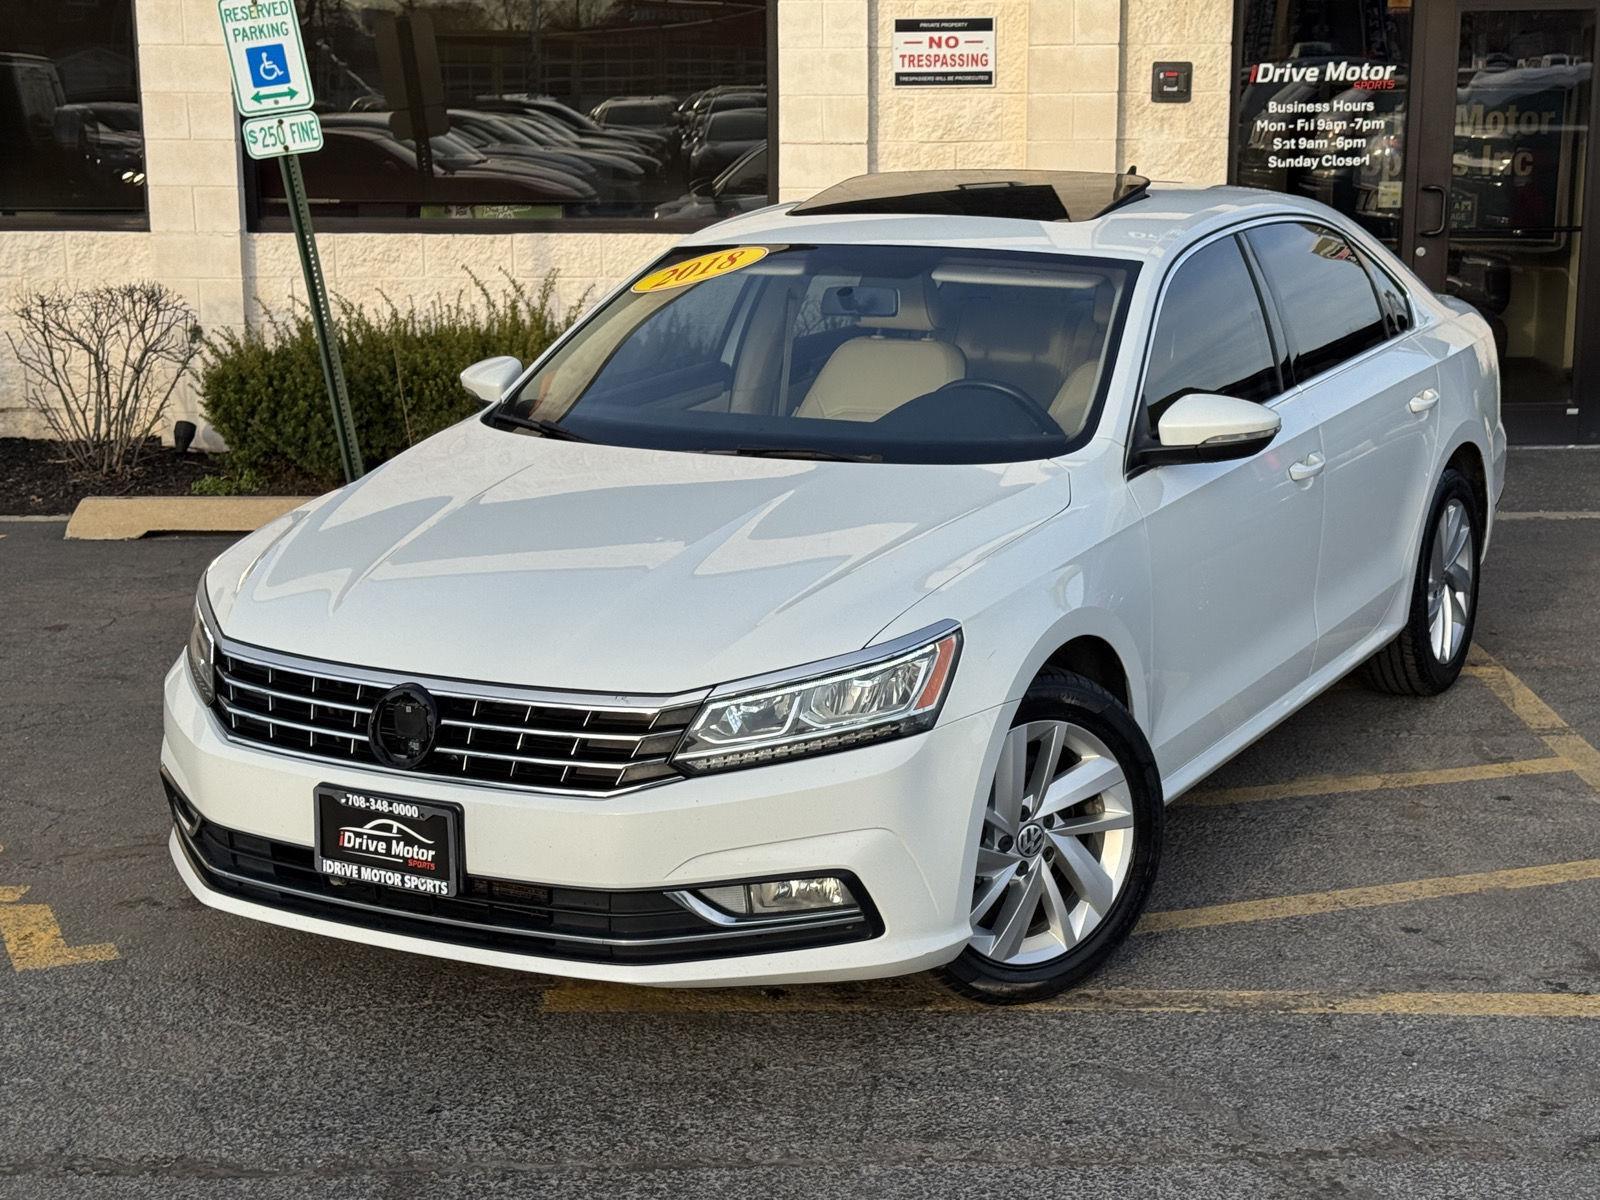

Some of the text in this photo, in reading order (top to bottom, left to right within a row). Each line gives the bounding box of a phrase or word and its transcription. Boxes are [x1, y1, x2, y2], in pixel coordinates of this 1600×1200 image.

[223, 1, 289, 23] RESERVED
[232, 21, 289, 43] PARKING
[928, 35, 960, 49] NO
[899, 53, 989, 68] TRESPASSING
[1325, 61, 1397, 82] Motor
[1353, 79, 1396, 90] SPORTS
[1268, 100, 1375, 114] Business Hours
[1256, 119, 1286, 132] Mon
[1317, 119, 1347, 131] 9am
[1454, 104, 1556, 136] Motor
[289, 120, 319, 144] FINE
[1272, 138, 1296, 150] Sat
[1298, 137, 1328, 149] 9am
[1267, 154, 1370, 170] Sunday Closed
[650, 250, 746, 289] 2018
[346, 793, 419, 818] 708-348-0000
[338, 831, 436, 862] iDrive Motor
[407, 859, 436, 871] SPORTS
[360, 866, 402, 887] MOTOR
[404, 875, 448, 895] SPORTS
